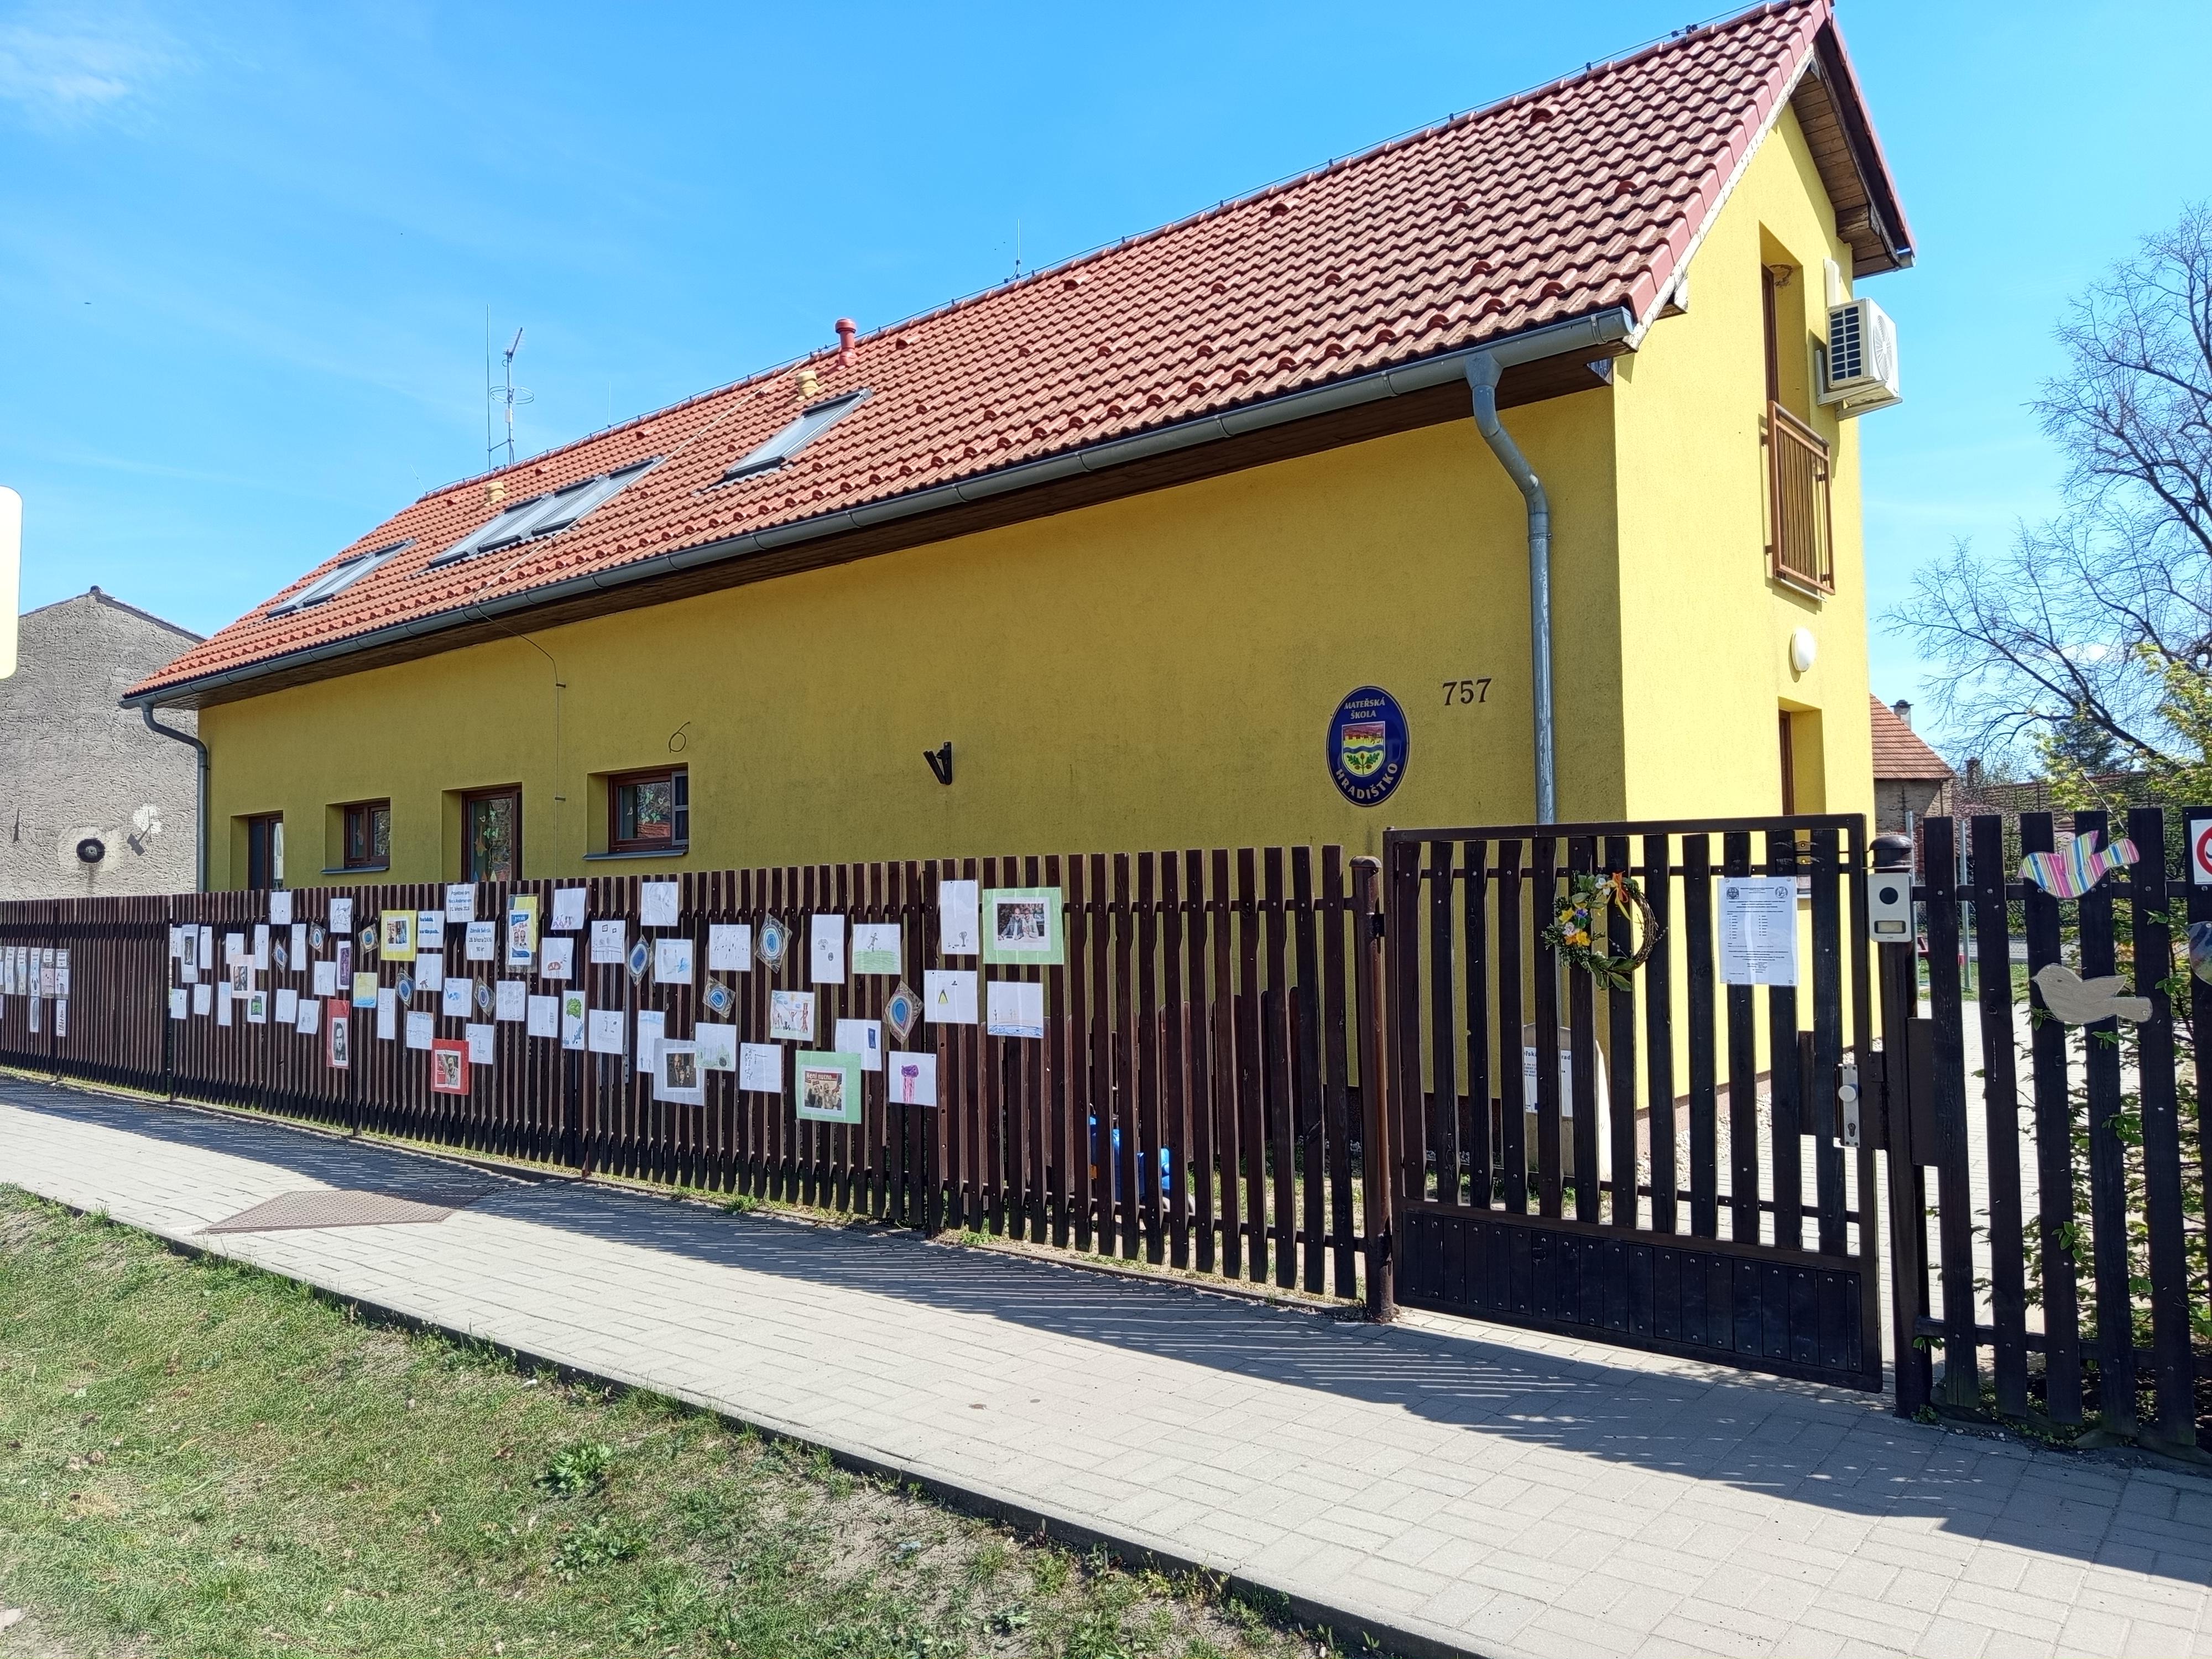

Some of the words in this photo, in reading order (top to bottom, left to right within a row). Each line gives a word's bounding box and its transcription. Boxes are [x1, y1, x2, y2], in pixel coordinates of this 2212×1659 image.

[1442, 677, 1492, 706] 757
[1344, 697, 1386, 710] MATEŘSKÁ
[1350, 709, 1376, 719] ŠKOLA
[1335, 763, 1398, 800] HRADIŠTKO
